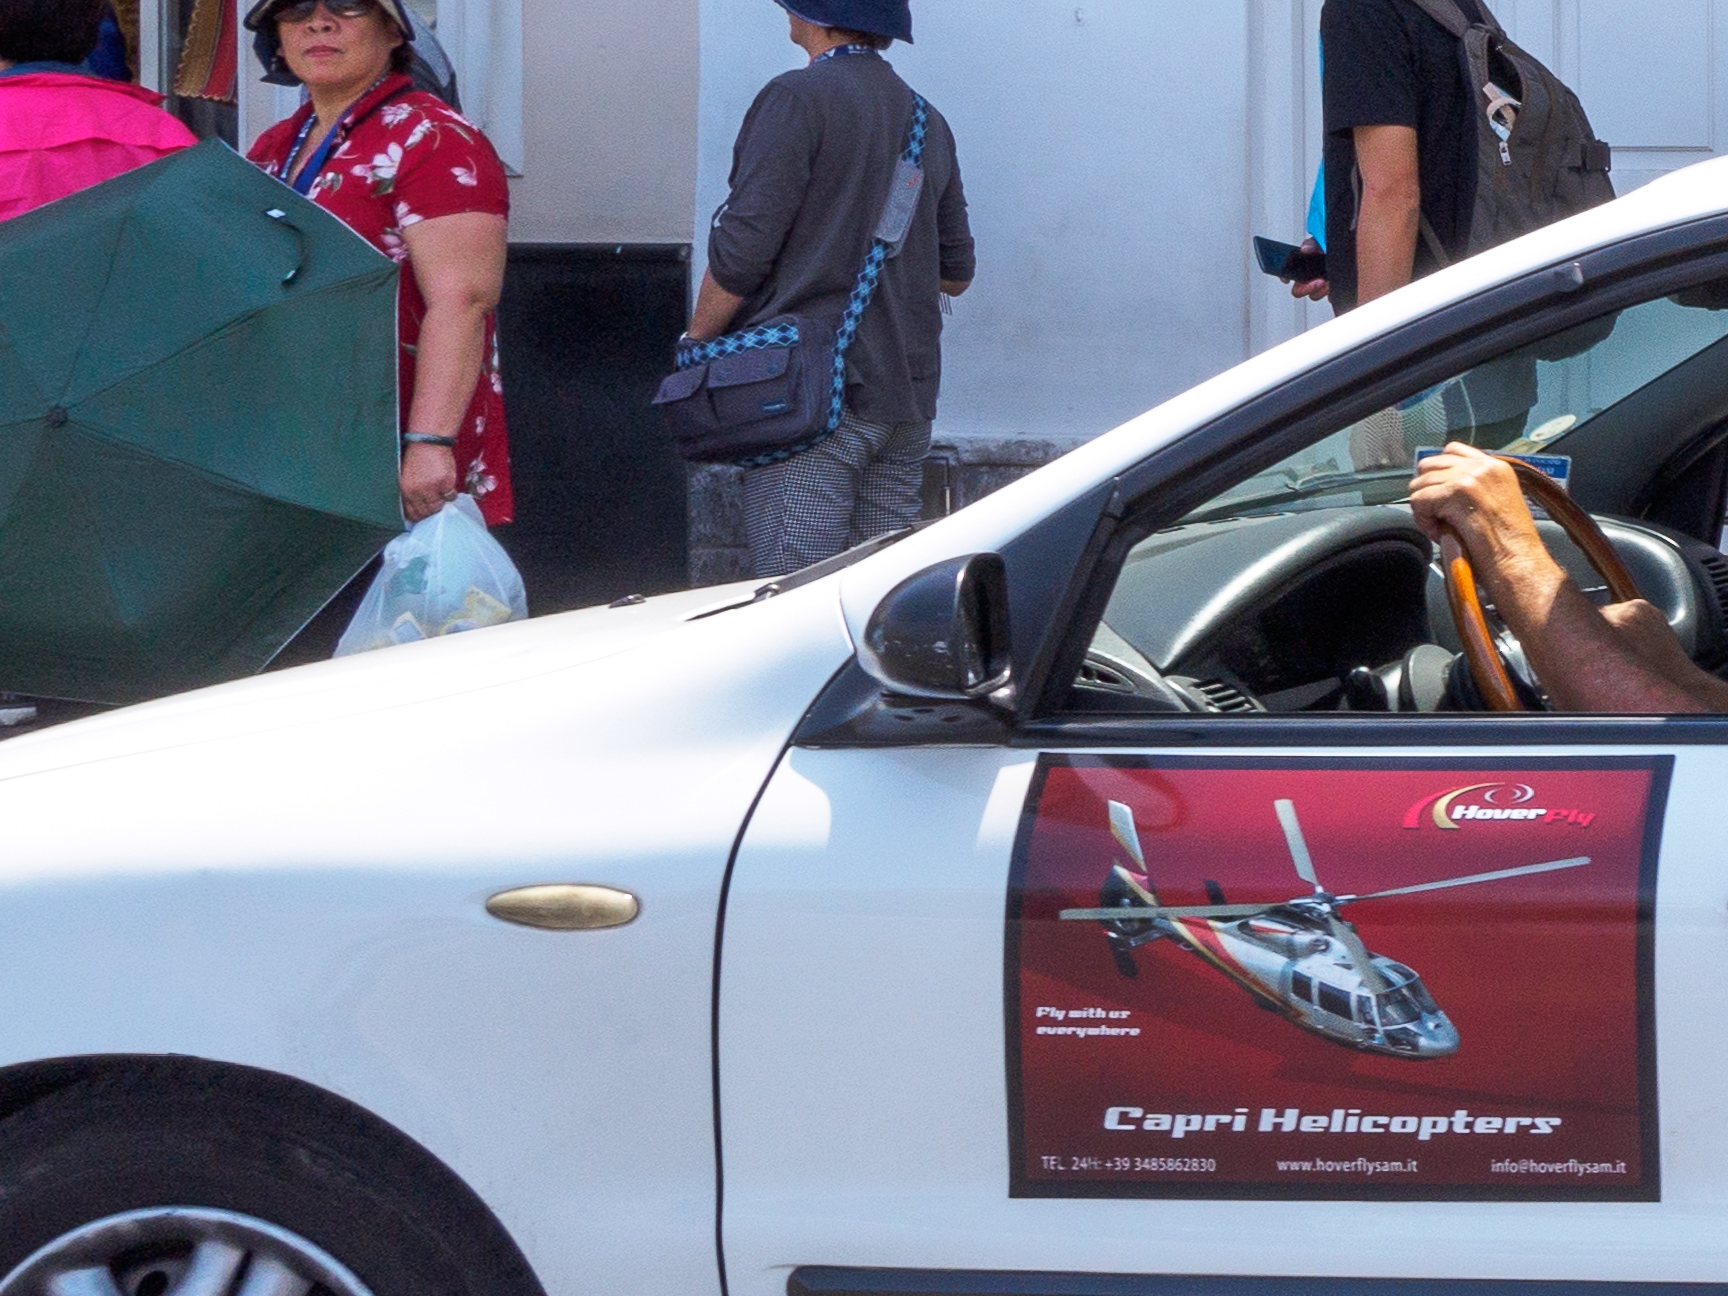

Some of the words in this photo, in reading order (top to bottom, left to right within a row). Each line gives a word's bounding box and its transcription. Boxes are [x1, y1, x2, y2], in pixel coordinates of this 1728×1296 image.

[1035, 1006, 1066, 1021] Fly
[1067, 1007, 1107, 1018] with
[1108, 1010, 1131, 1019] us
[1036, 1024, 1141, 1038] everywhere
[1103, 1106, 1249, 1139] Capri
[1258, 1108, 1562, 1141] Helicopters
[1105, 1158, 1131, 1171] +39
[1134, 1157, 1217, 1172] 3485862830
[1276, 1158, 1418, 1175] www.hoverflysam.it
[1491, 1159, 1627, 1177] info@hoverflysam.it
